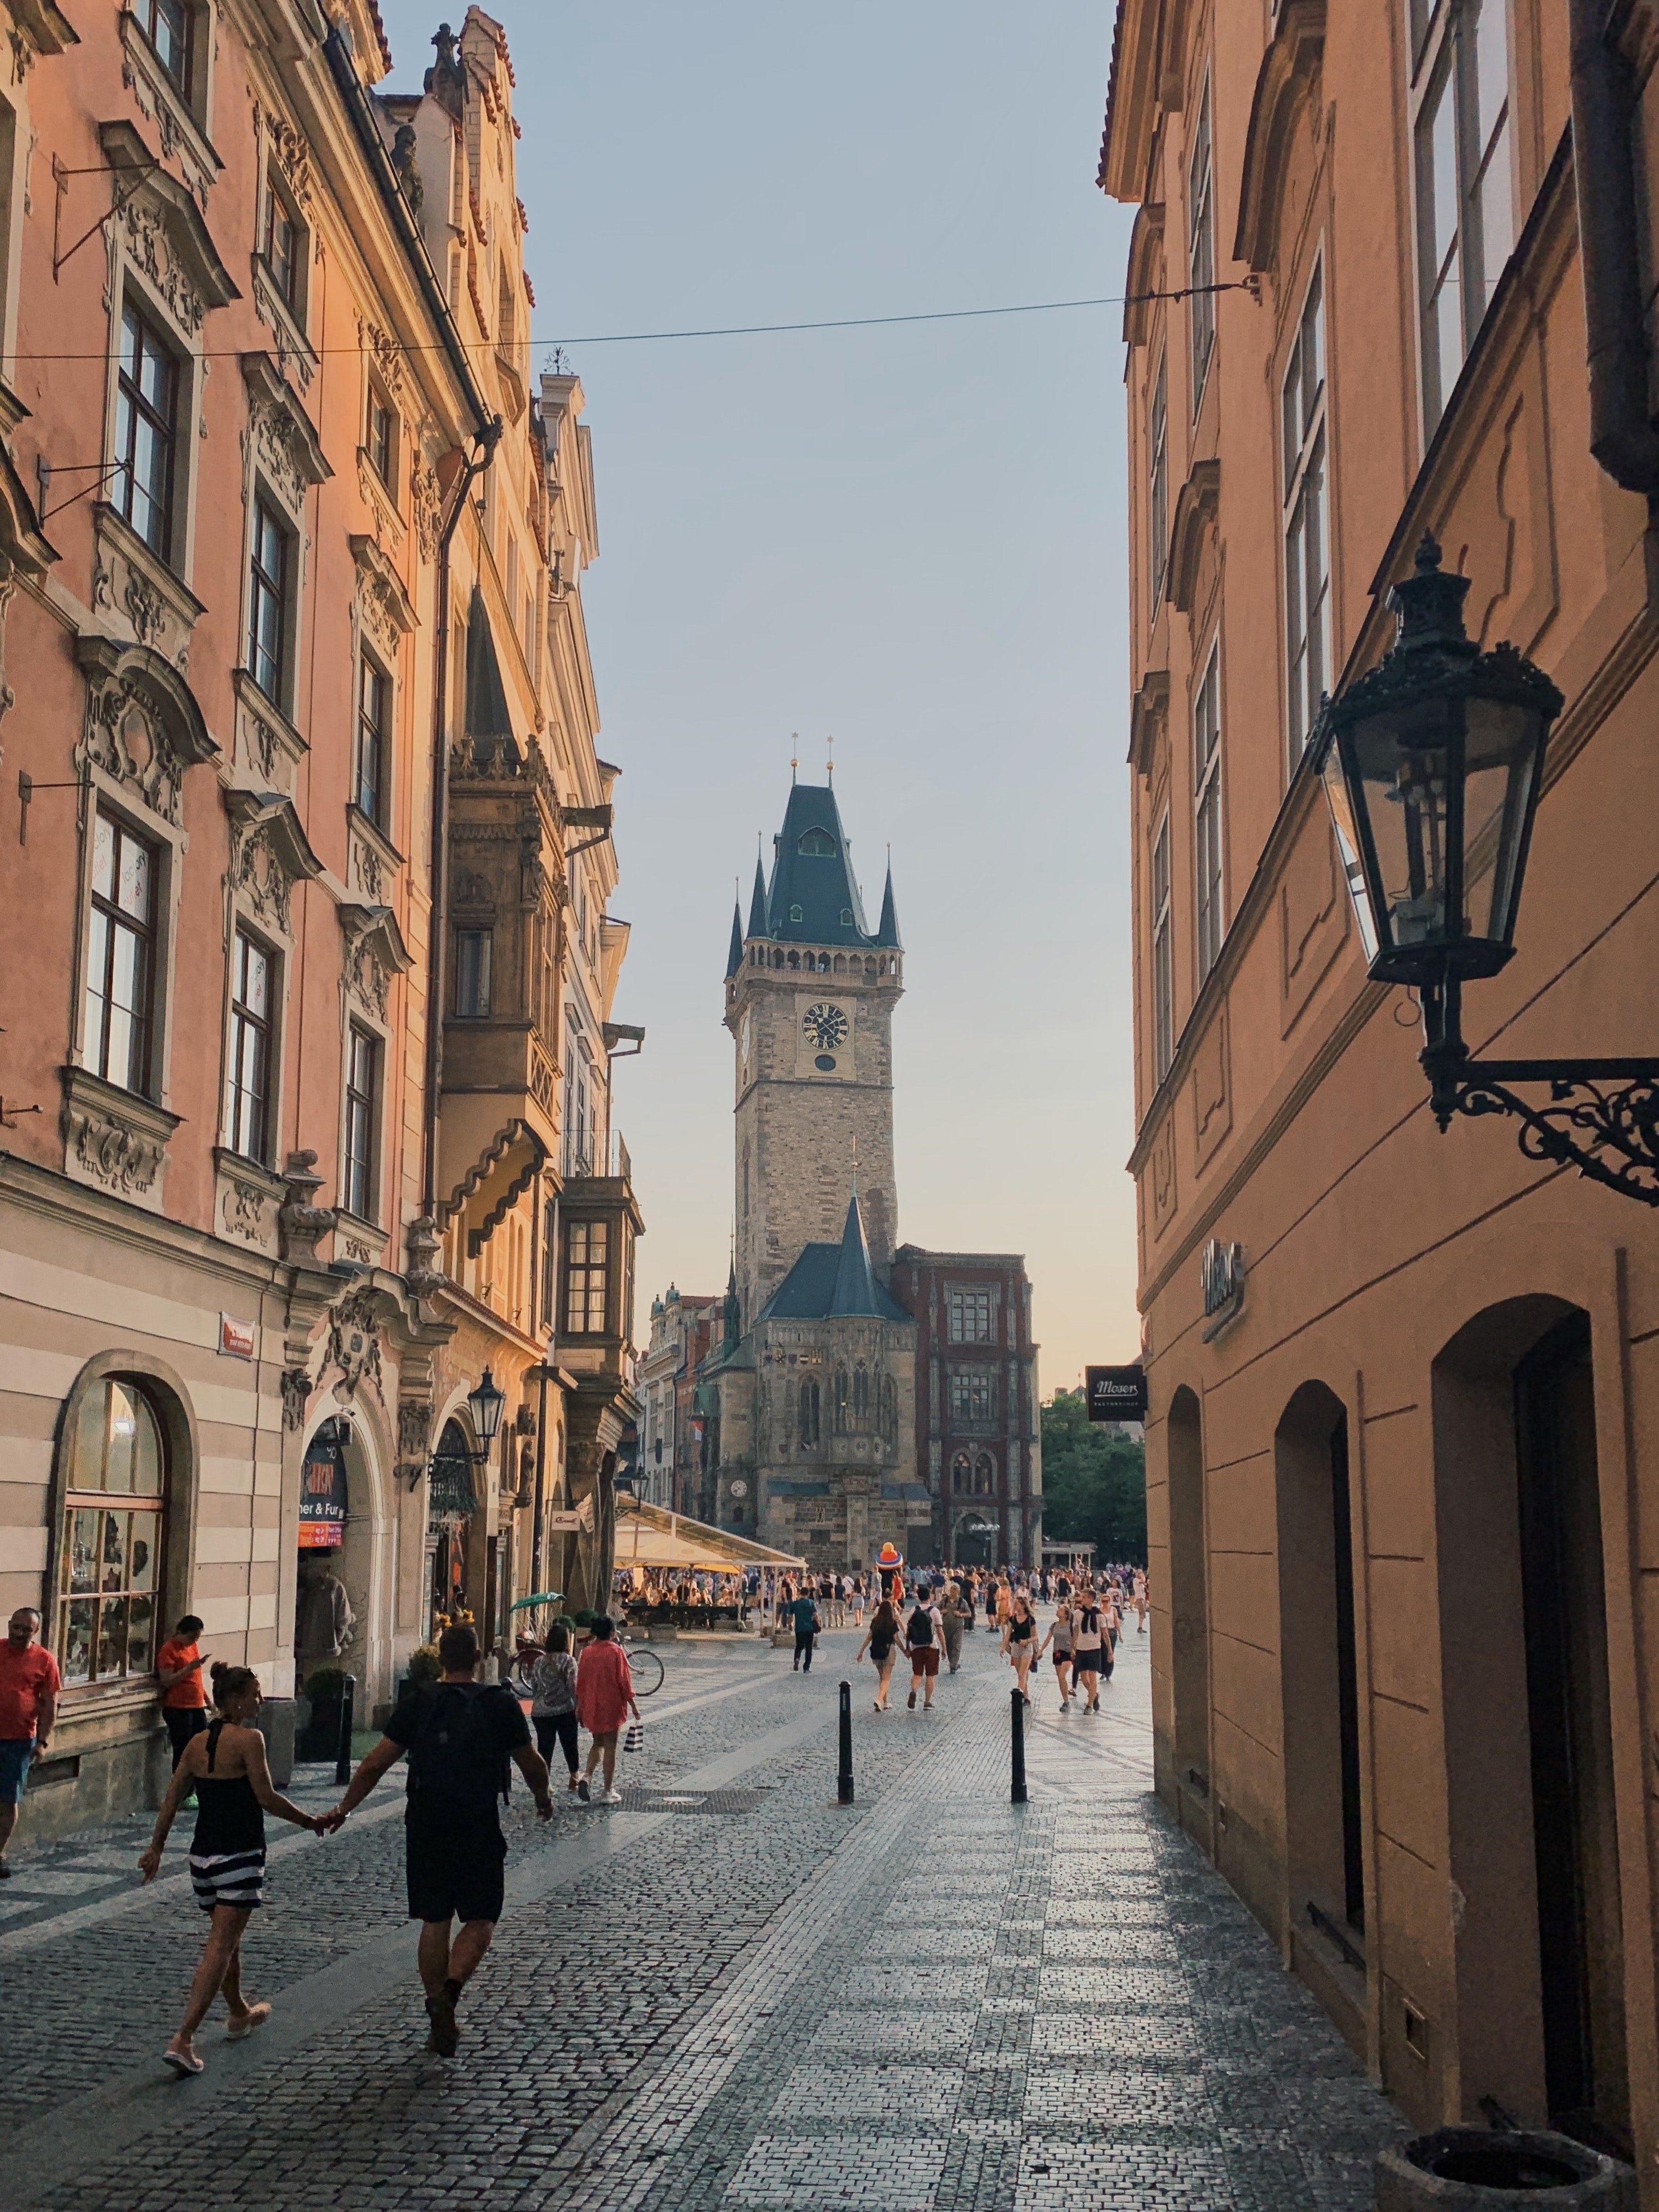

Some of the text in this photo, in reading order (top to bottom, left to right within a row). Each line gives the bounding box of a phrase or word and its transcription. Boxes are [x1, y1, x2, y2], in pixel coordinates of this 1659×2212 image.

[1097, 1380, 1138, 1395] Moser
[315, 1503, 323, 1515] &
[325, 1503, 338, 1515] Fur
